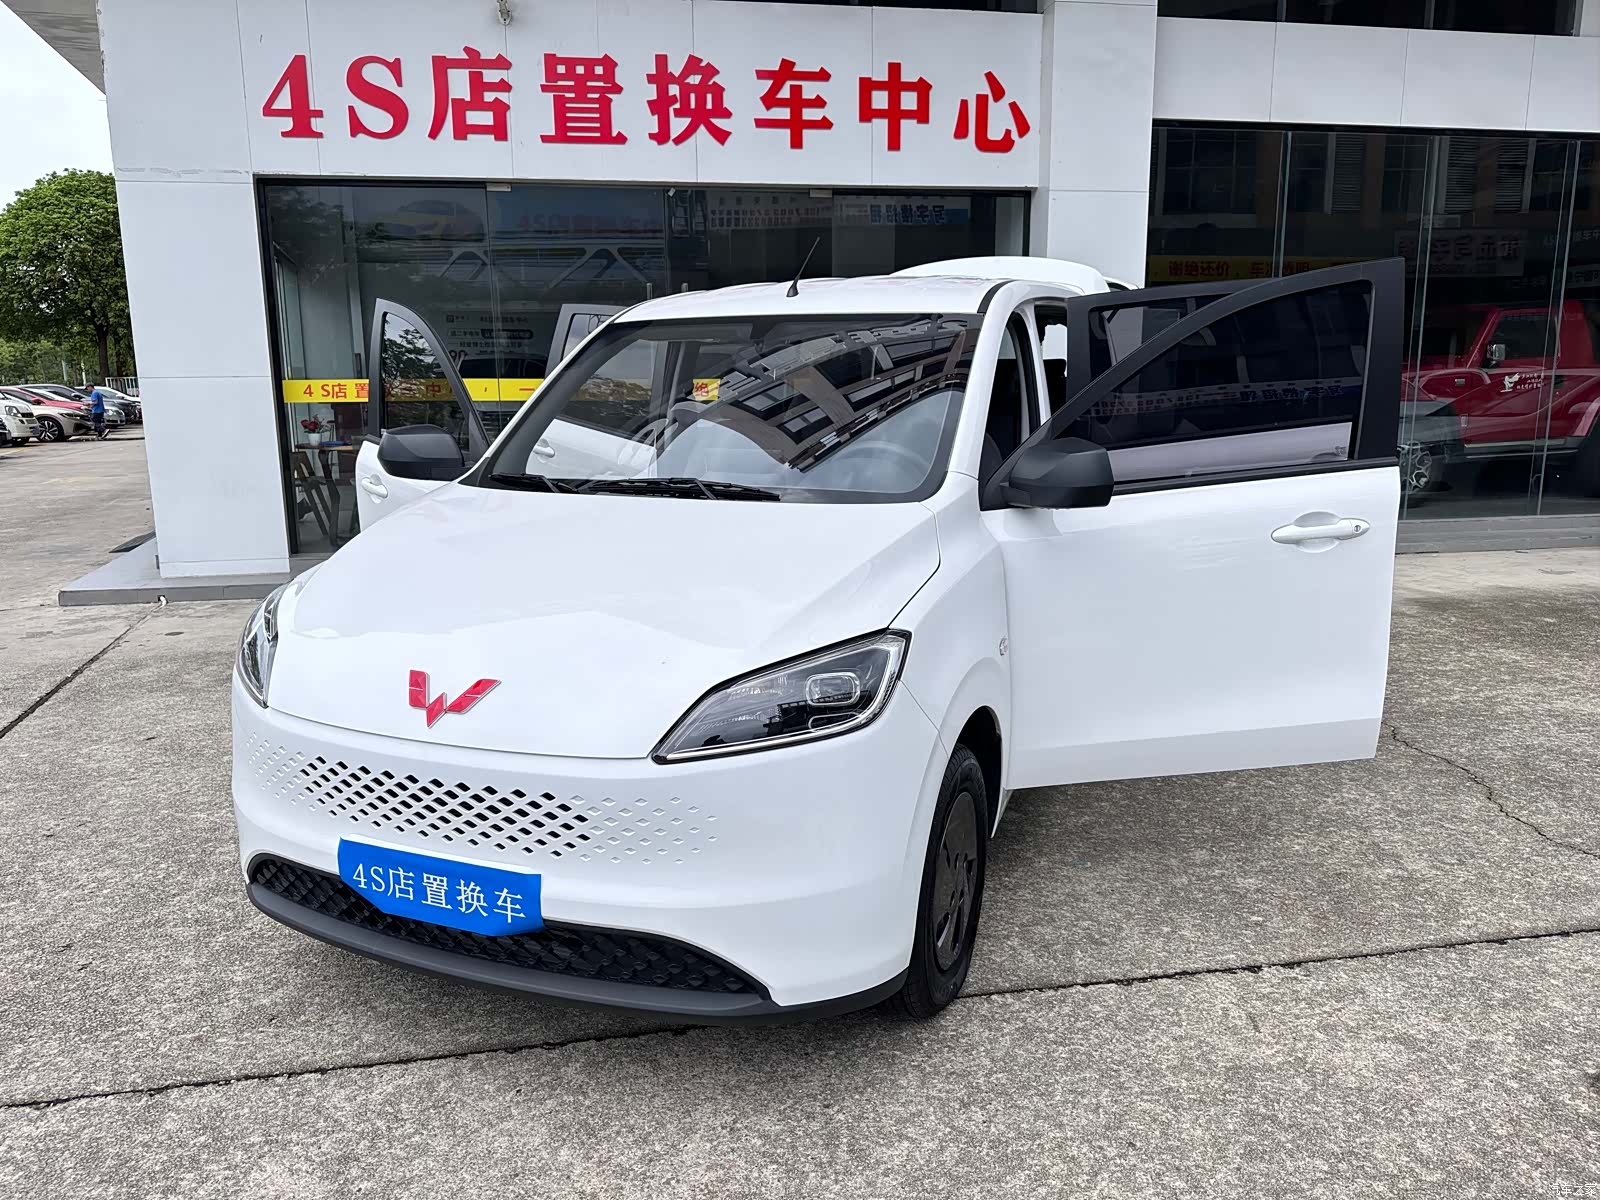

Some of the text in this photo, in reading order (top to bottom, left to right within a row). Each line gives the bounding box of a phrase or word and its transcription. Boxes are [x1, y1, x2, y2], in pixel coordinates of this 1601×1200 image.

[262, 46, 1031, 155] 4S店置换车中心
[352, 862, 527, 924] 4S店置换车
